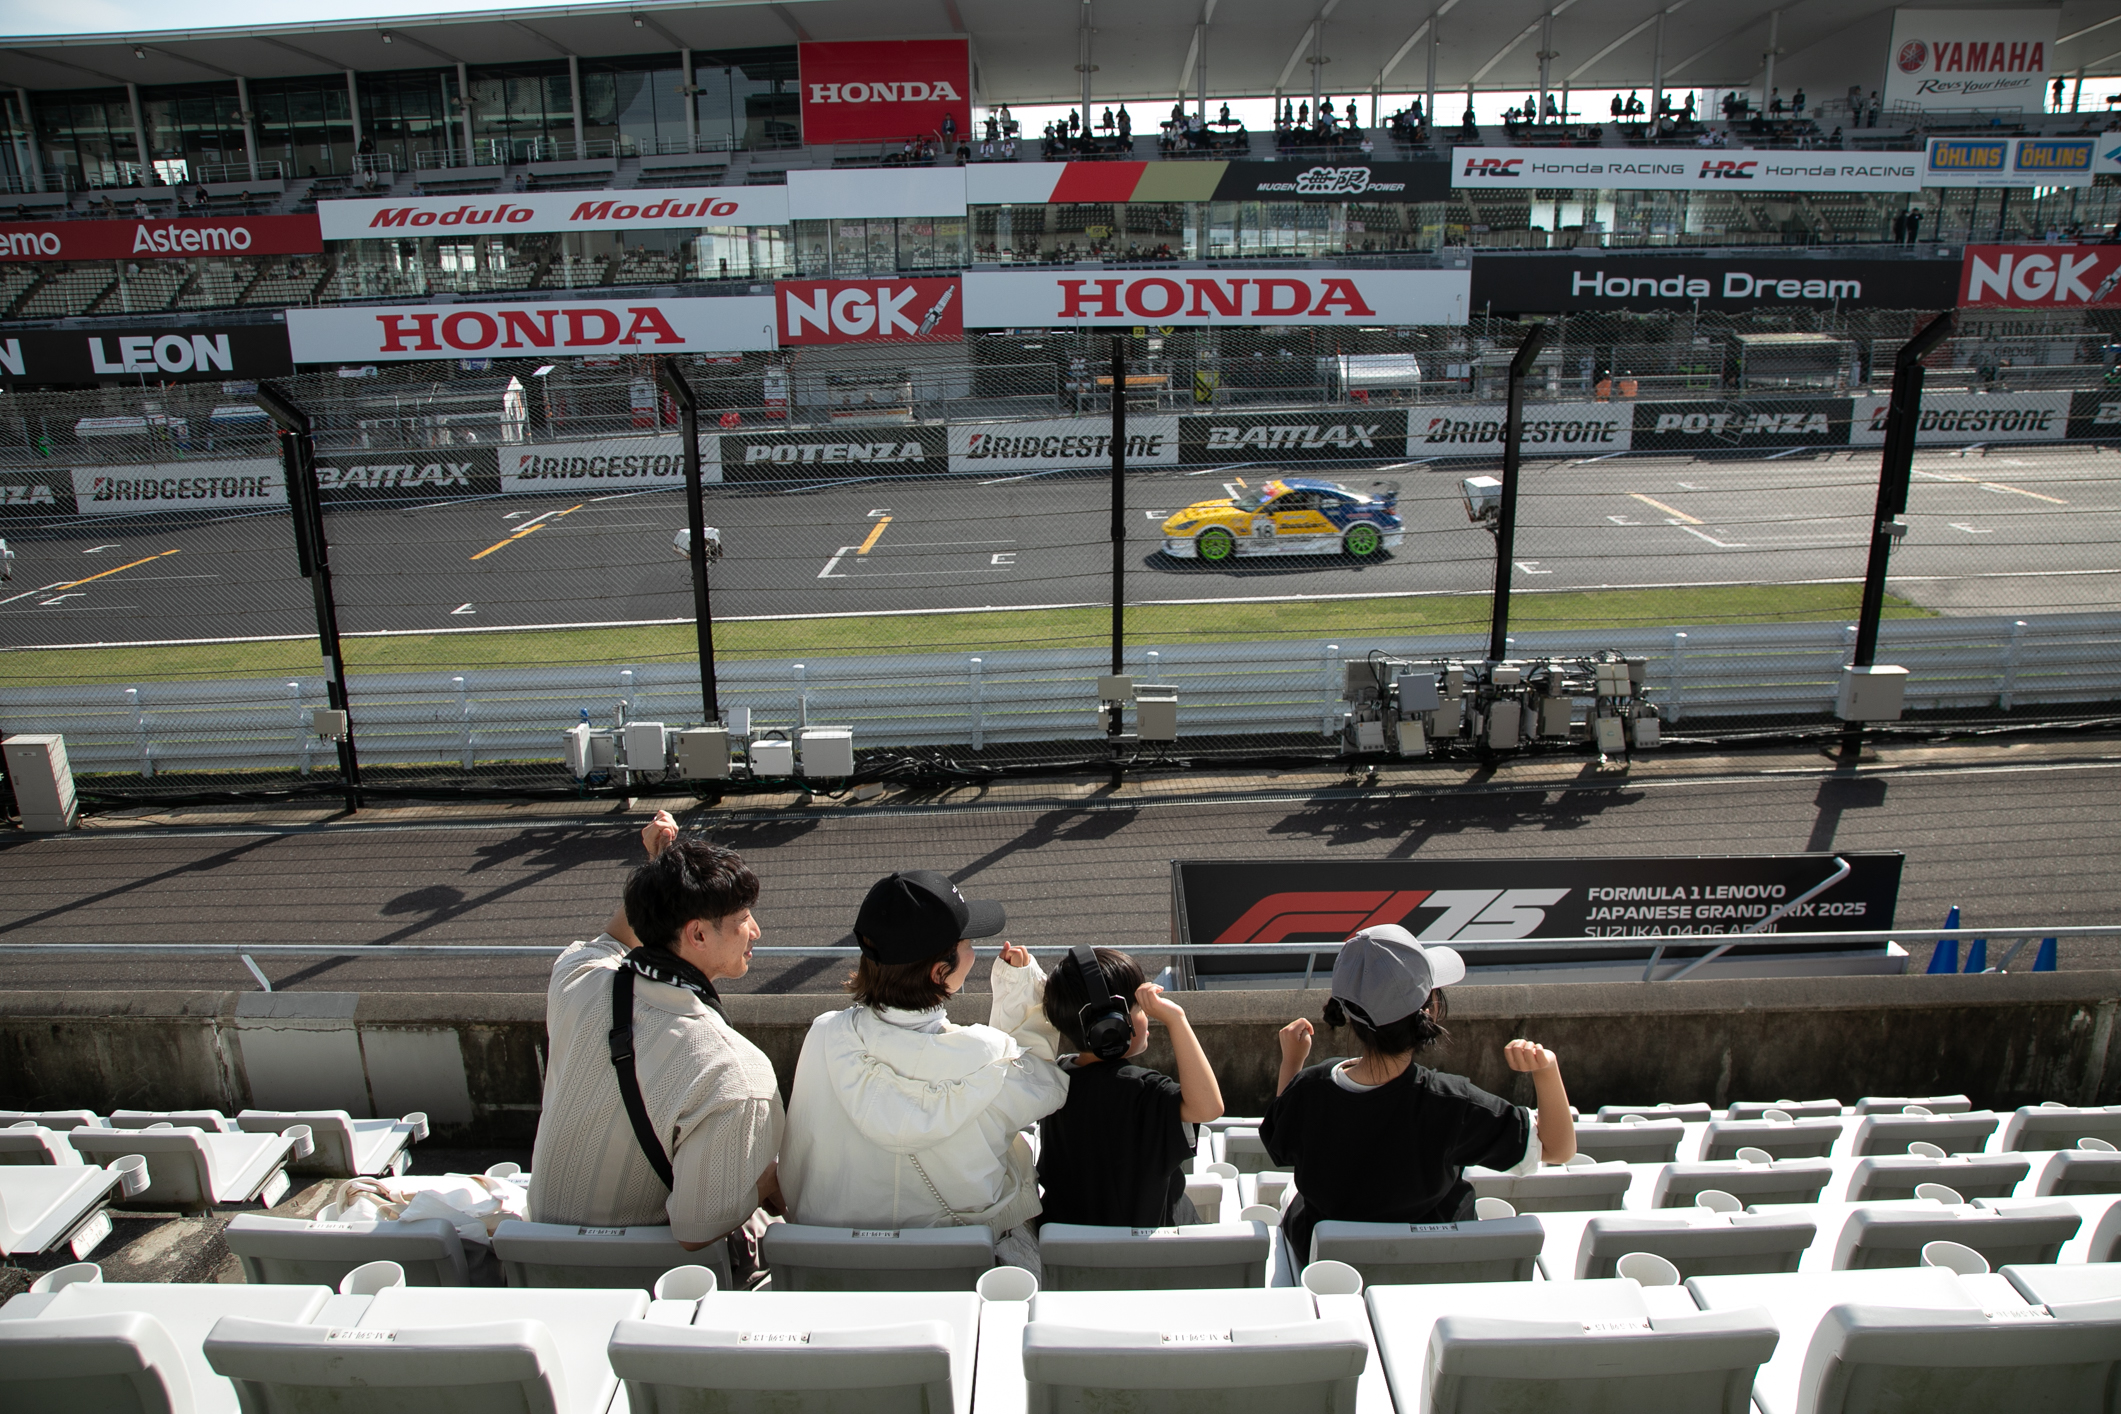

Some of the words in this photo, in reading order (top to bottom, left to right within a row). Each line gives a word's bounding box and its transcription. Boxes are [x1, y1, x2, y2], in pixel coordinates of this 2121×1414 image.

[1933, 42, 2043, 73] YAMAHA
[809, 81, 961, 104] HONDA
[1916, 79, 1962, 95] Revs
[1962, 79, 1994, 94] Your
[1995, 78, 2031, 88] Heart
[1464, 158, 1524, 177] HRC
[1532, 163, 1602, 174] Honda
[1608, 163, 1685, 175] RACING
[1935, 143, 2002, 167] ÖHLINS
[2020, 143, 2088, 167] ÖHLINS
[1257, 183, 1297, 191] MUGEN
[1296, 167, 1372, 194] 無限
[1367, 183, 1405, 192] POWER
[1699, 161, 1758, 179] HRC
[1766, 165, 1836, 176] Honda
[1841, 166, 1916, 178] RACING
[369, 204, 534, 228] Modulo
[569, 197, 739, 221] Modulo
[133, 224, 252, 254] Astemo
[1571, 271, 1710, 297] Honda
[1723, 273, 1861, 298] Dream
[1967, 252, 2100, 302] NGK
[1057, 277, 1376, 318] HONDA
[786, 285, 919, 336] NGK
[376, 307, 685, 352] HONDA
[88, 334, 234, 374] LEON
[1867, 406, 2056, 432] BDGESTONE
[1206, 425, 1381, 450] BATTLAX
[744, 442, 926, 466] POTENZA
[92, 475, 271, 501] BRIDGESTONE
[315, 462, 473, 489] BATTLAX
[1588, 887, 1688, 901] FORMULA
[1689, 887, 1701, 900] 1
[1704, 885, 1786, 899] LENOVO
[1418, 888, 1572, 941] 75
[1586, 905, 1692, 920] JAPANESE
[1695, 904, 1767, 918] GRAND
[1818, 902, 1867, 917] 2025
[1584, 925, 1663, 938] SUZUKA
[1667, 924, 1724, 936] 04-06
[754, 1334, 798, 1342] M-5列-13
